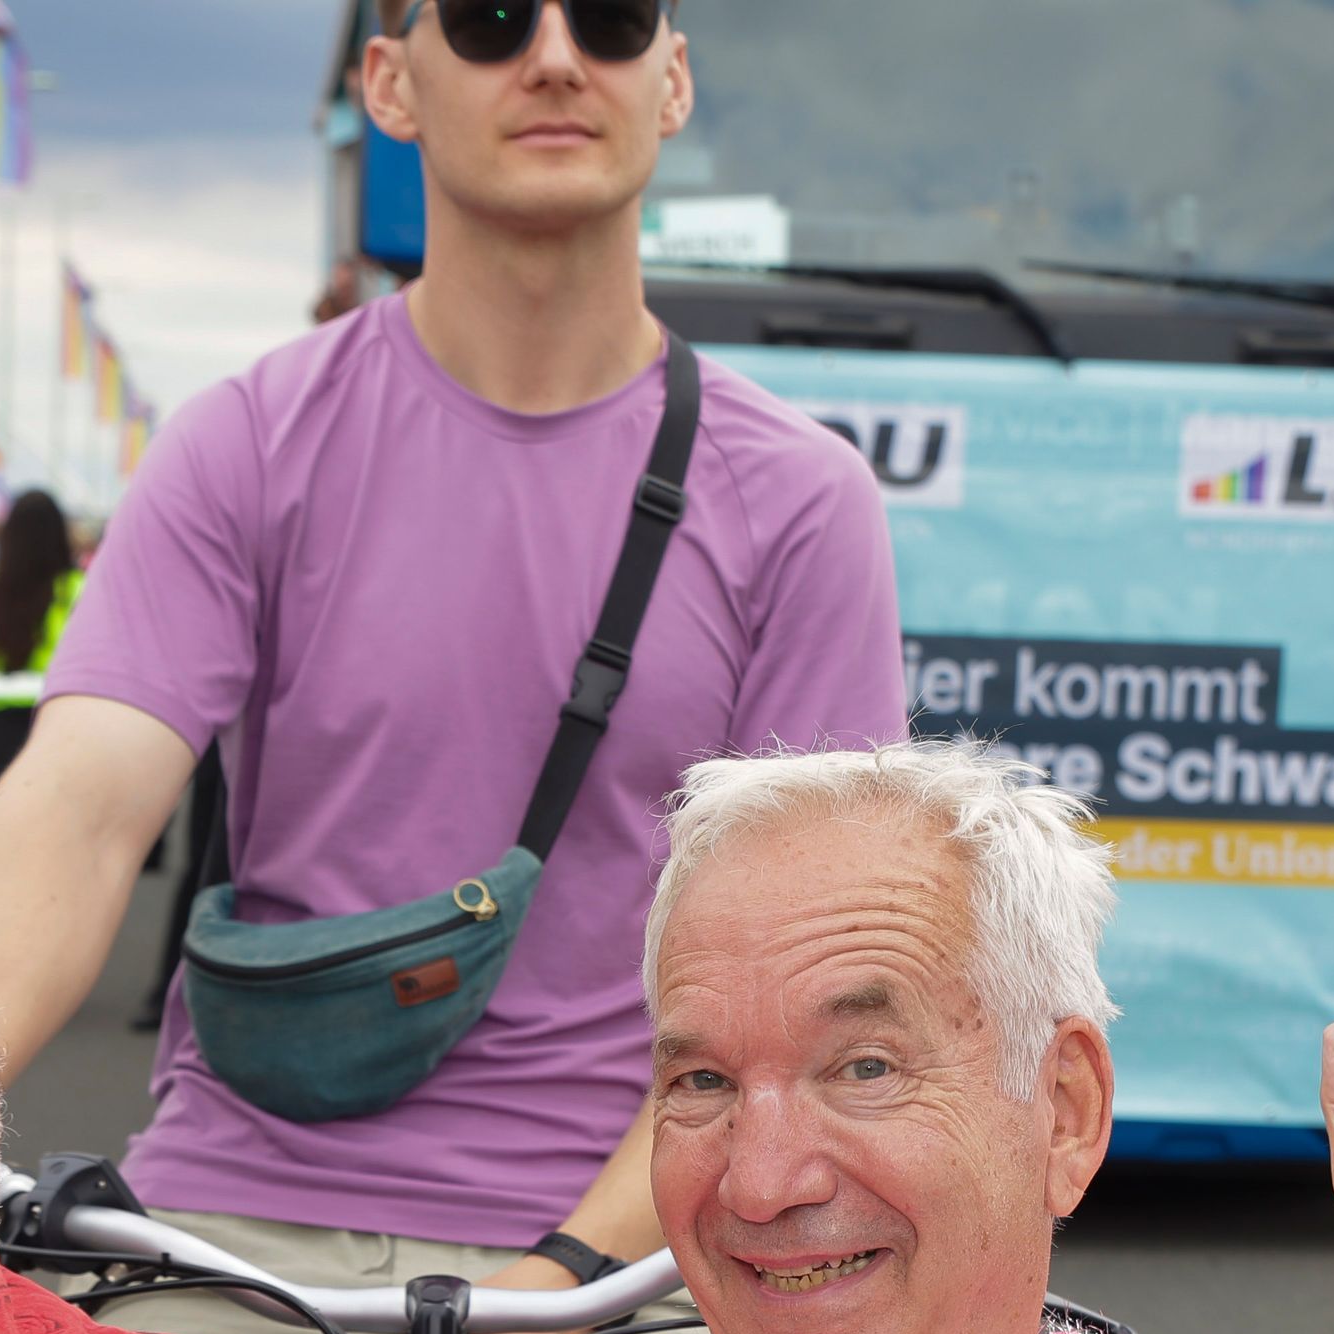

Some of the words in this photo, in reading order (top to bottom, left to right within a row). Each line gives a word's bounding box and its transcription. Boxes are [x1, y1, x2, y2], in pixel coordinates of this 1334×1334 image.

[817, 414, 948, 488] U
[905, 641, 1000, 716] ier
[1014, 645, 1271, 725] kommt
[981, 741, 1105, 798] re
[1120, 828, 1201, 873] der
